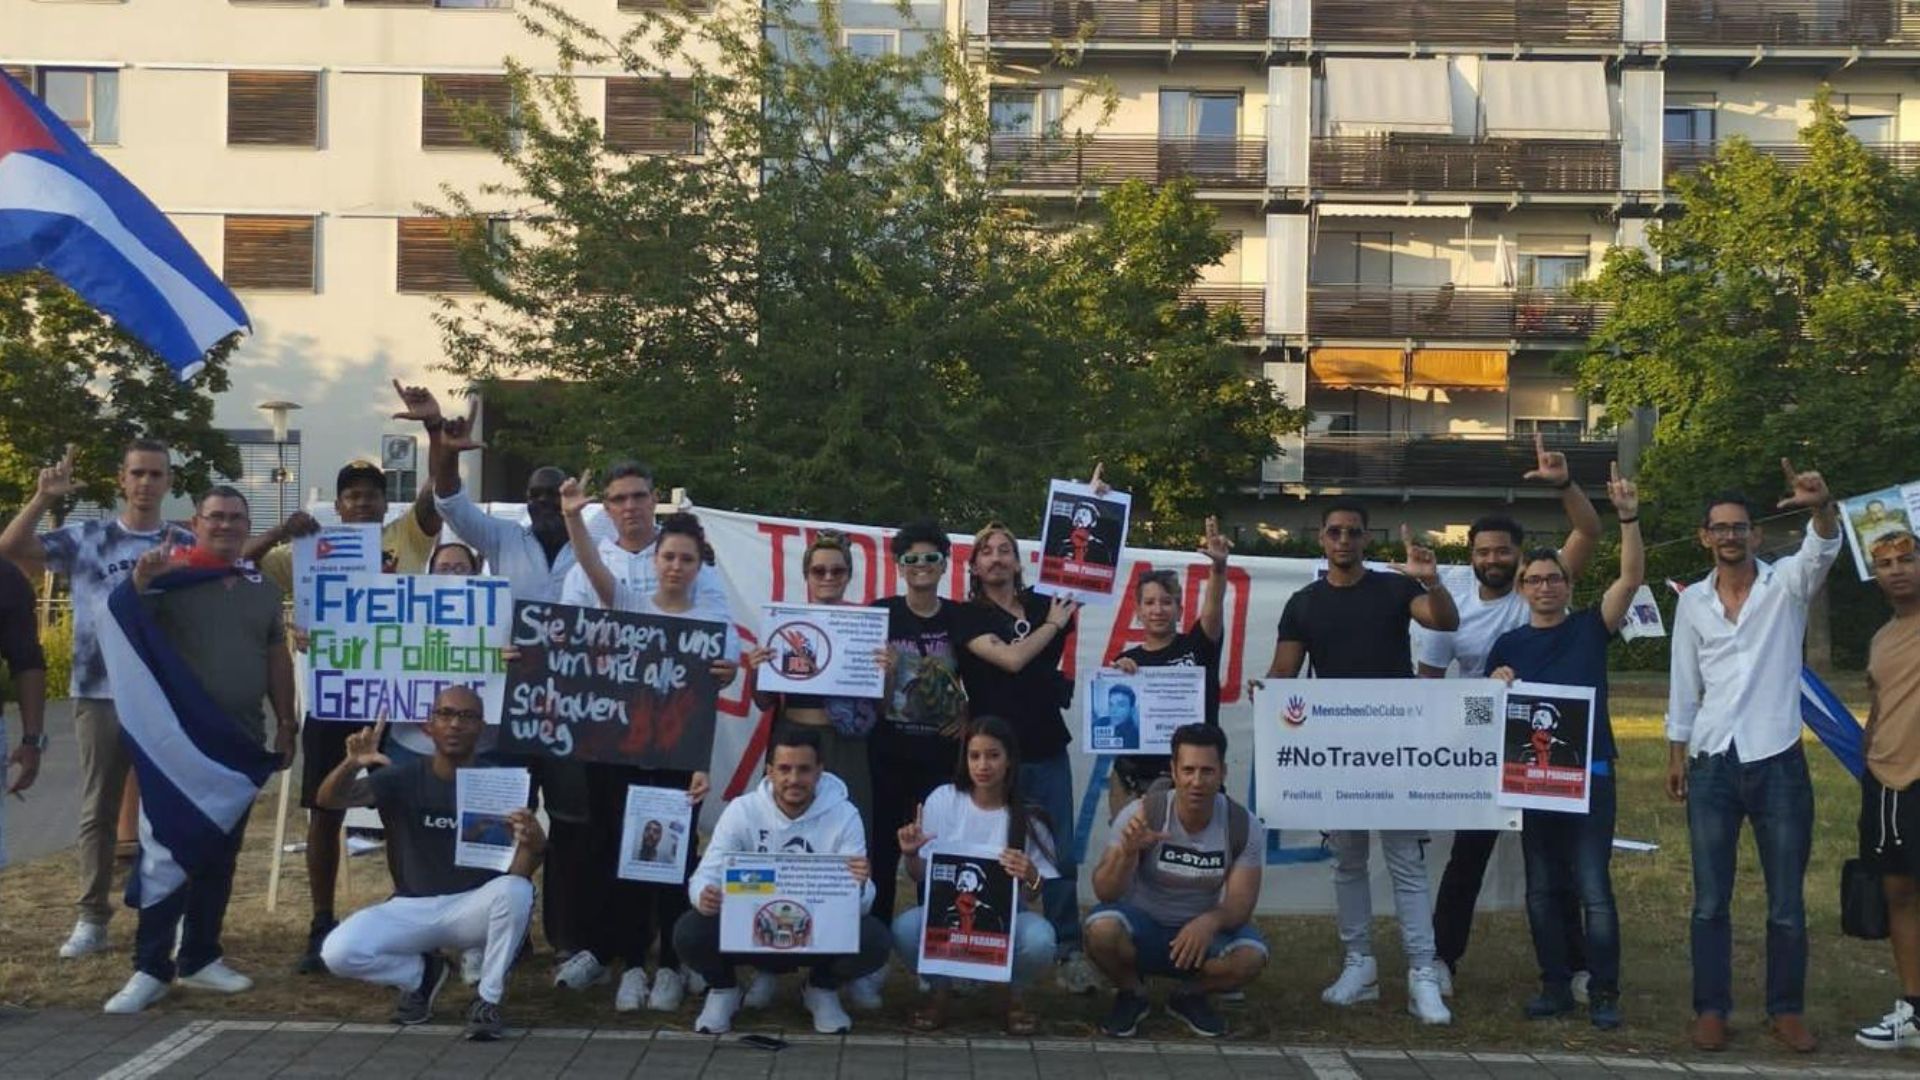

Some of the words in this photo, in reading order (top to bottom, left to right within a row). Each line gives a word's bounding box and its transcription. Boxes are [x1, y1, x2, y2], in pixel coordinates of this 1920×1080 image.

[514, 605, 566, 647] Sie
[570, 608, 667, 651] bringen
[679, 629, 724, 661] uns
[549, 649, 593, 677] um
[644, 658, 687, 695] alle
[510, 677, 630, 726] schauen
[1312, 704, 1405, 717] MenschenDeCuba
[511, 718, 573, 756] weg
[1277, 747, 1498, 768] #NoTravelToCuba
[1283, 790, 1322, 800] Freiheit
[1336, 790, 1394, 800] Demokratie
[424, 815, 458, 829] Lev
[1164, 850, 1221, 867] G-STAR
